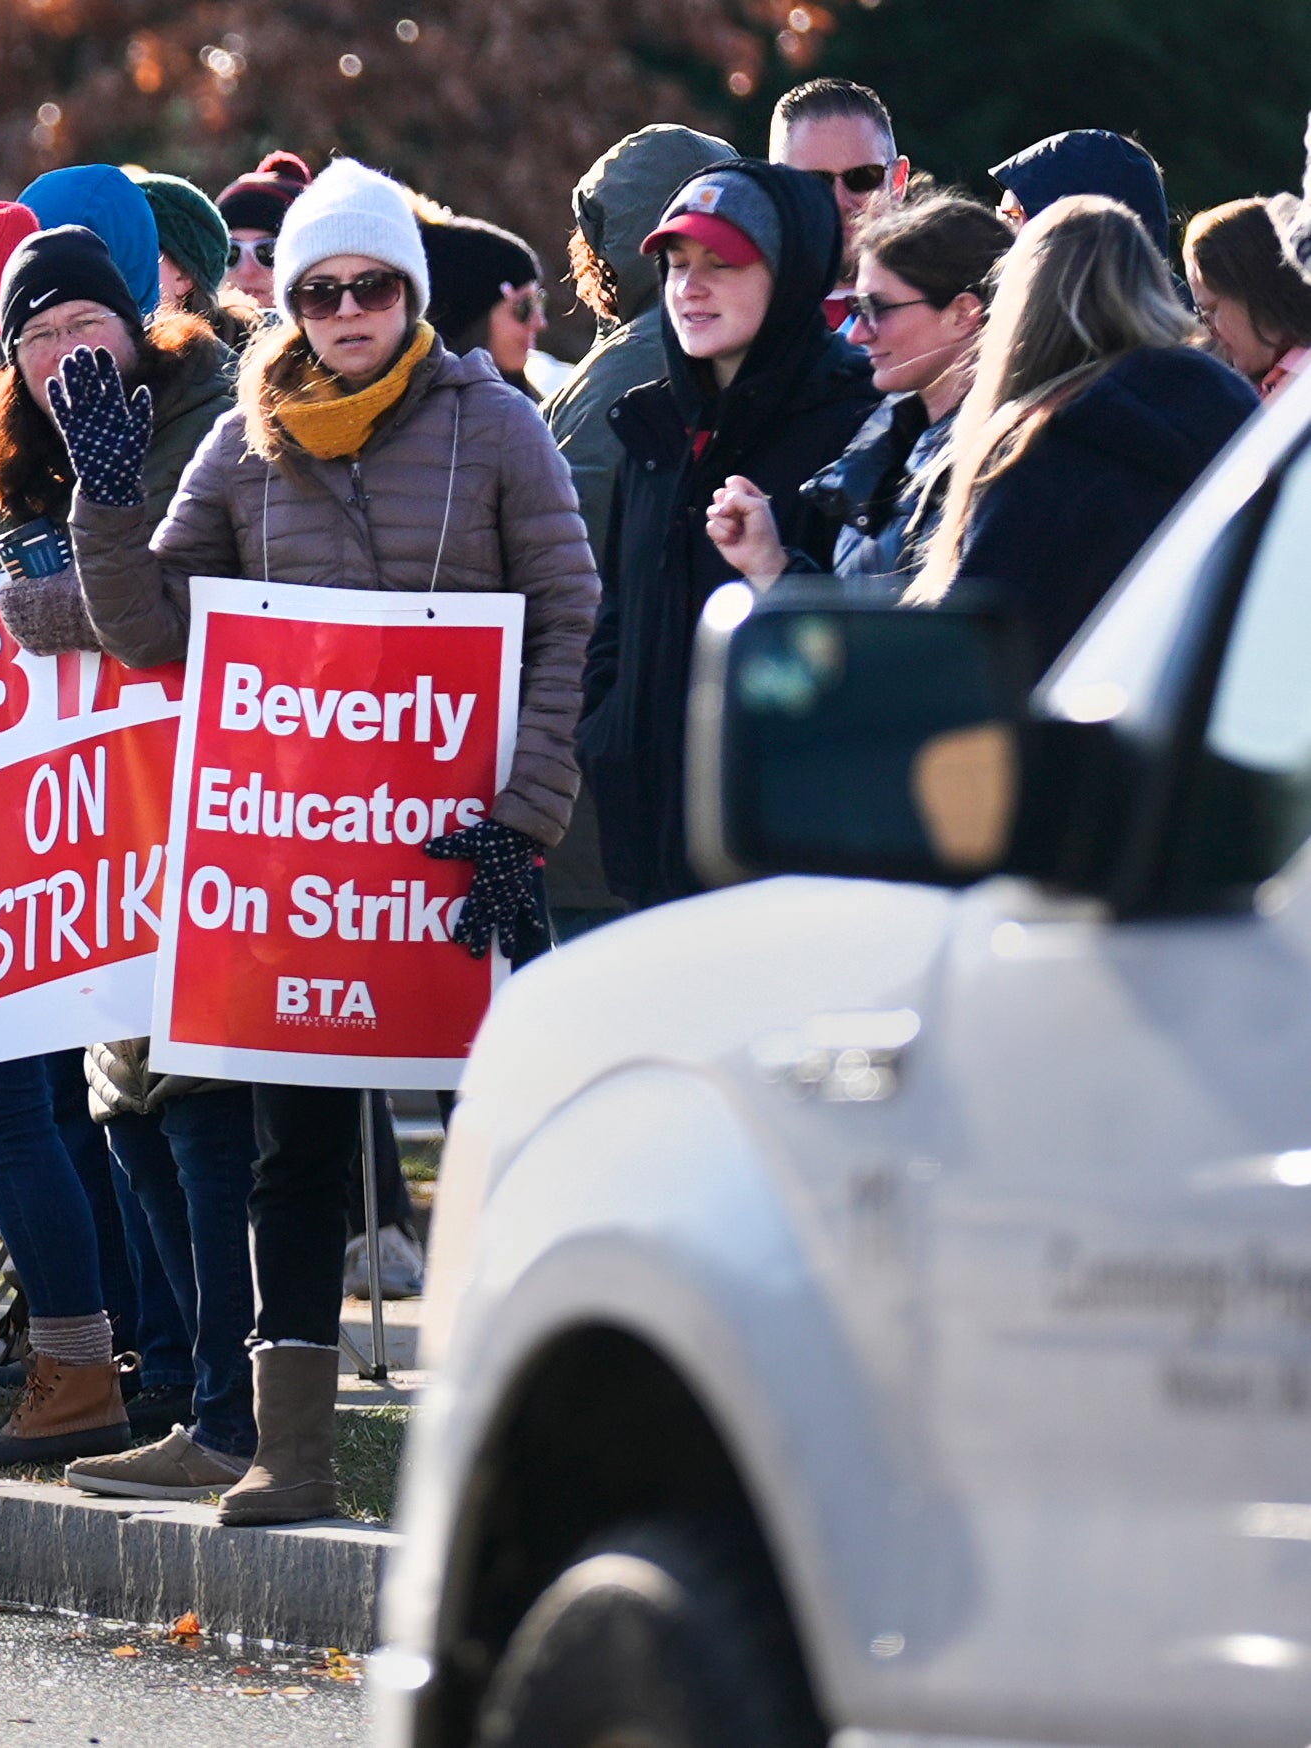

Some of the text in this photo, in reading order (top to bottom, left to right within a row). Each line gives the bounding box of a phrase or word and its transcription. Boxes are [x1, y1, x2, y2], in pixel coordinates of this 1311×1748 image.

[220, 662, 476, 761] Beverly
[25, 746, 106, 854] ON
[196, 767, 487, 845] Educators
[187, 865, 268, 933] On
[276, 976, 377, 1018] BTA
